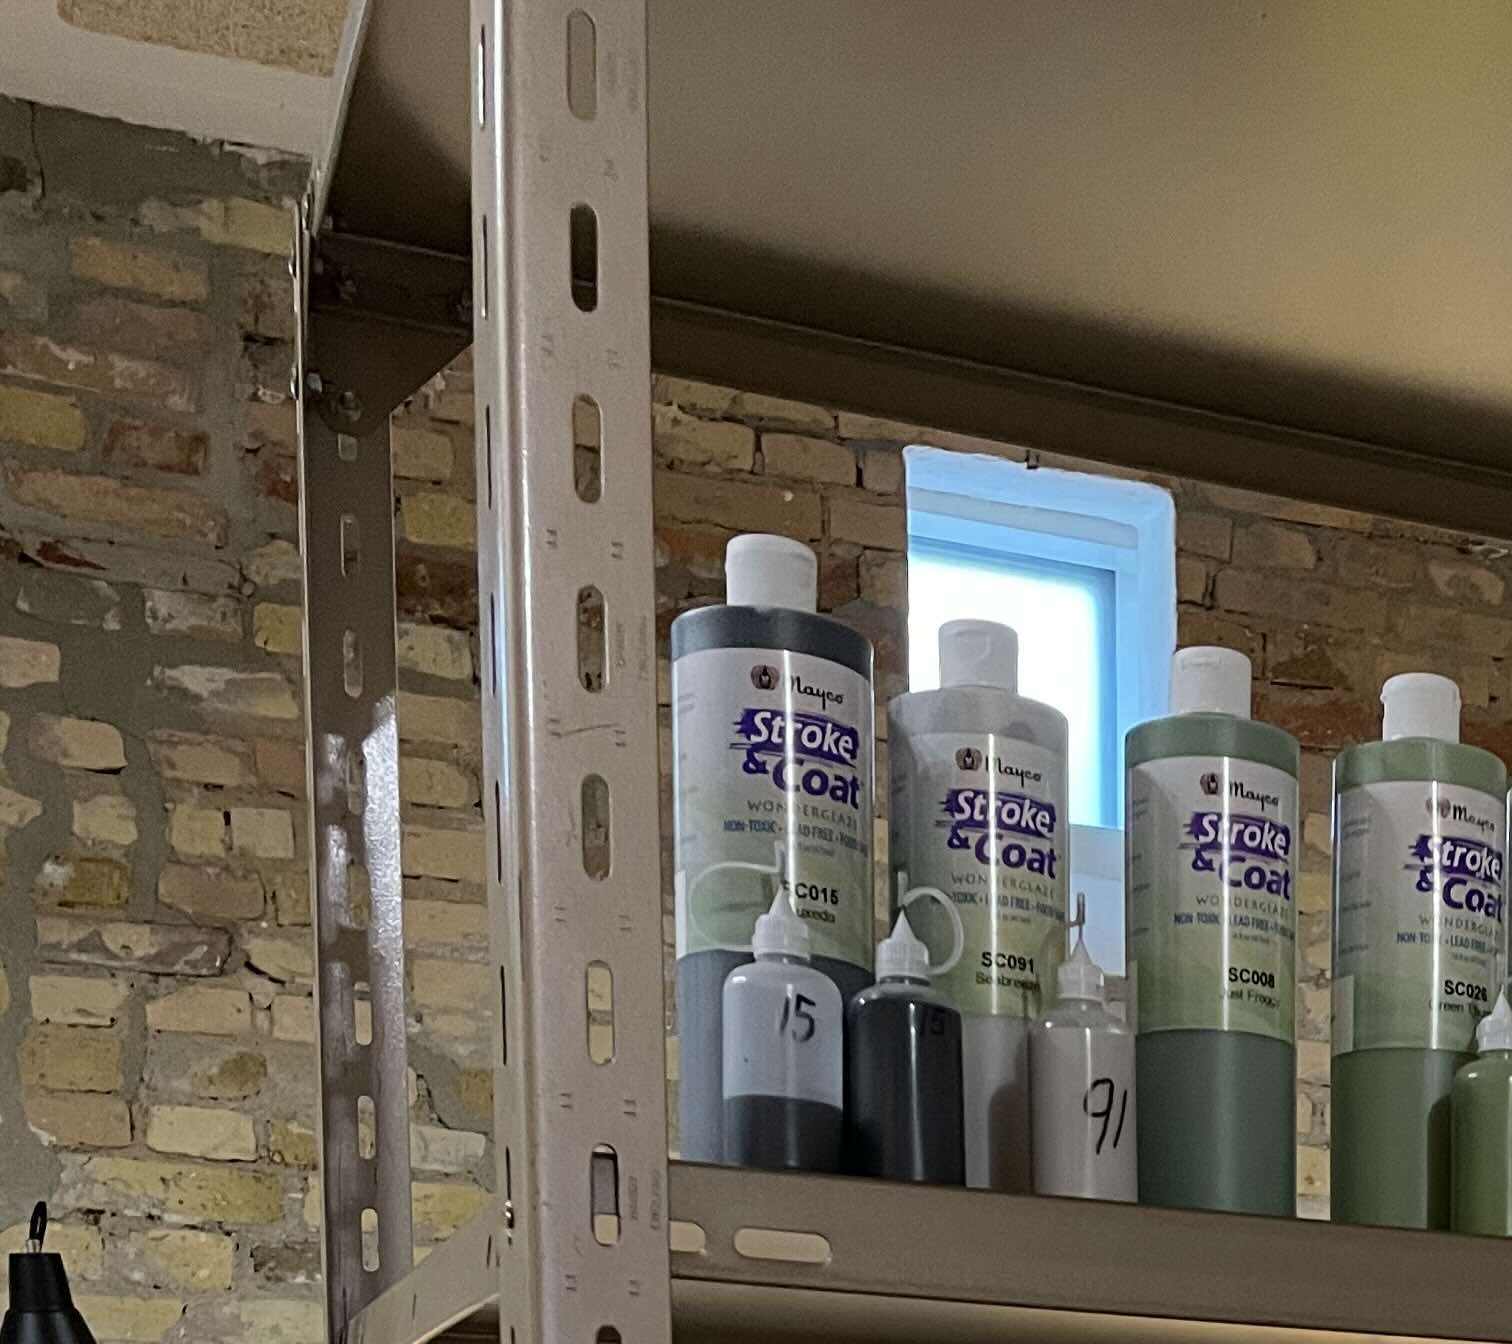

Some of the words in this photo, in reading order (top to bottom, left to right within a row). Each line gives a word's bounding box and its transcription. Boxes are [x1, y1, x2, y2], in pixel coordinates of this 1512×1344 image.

[749, 709, 855, 760] Stroke
[741, 749, 769, 776] &
[772, 758, 861, 810] Coat
[955, 790, 1053, 835] Stroke
[946, 827, 971, 851] &
[973, 836, 1057, 880] Coat
[980, 950, 1035, 974] SC091
[1227, 966, 1276, 989] SC008
[1443, 979, 1487, 1001] SC026
[779, 993, 817, 1042] 15
[1083, 1077, 1128, 1155] 91
